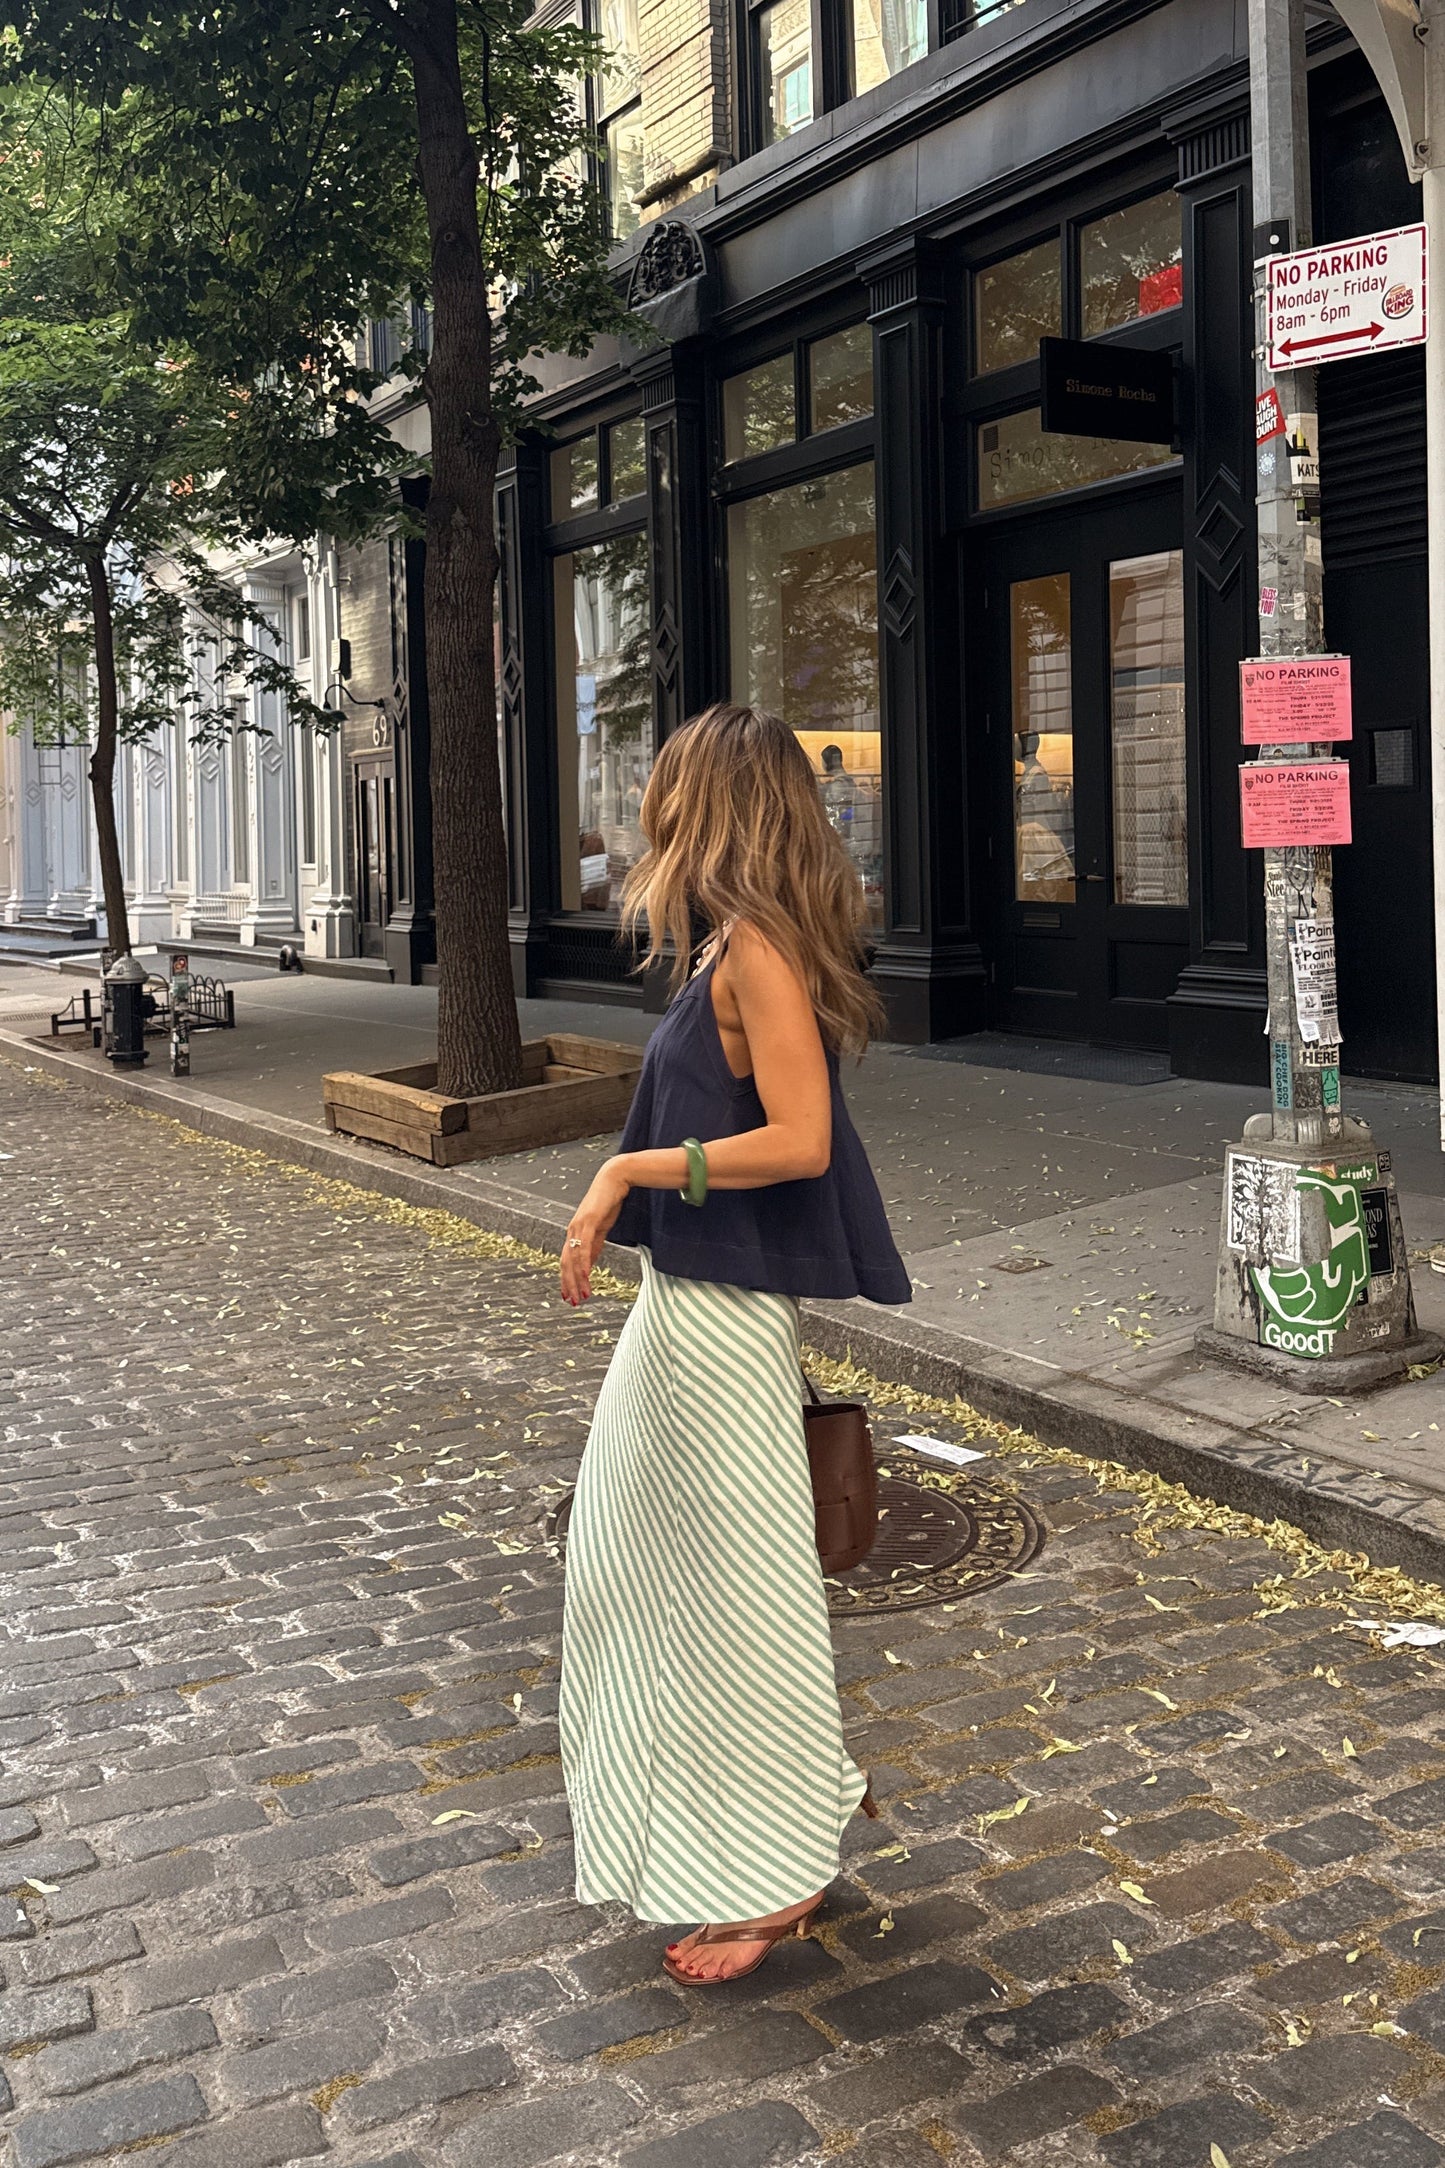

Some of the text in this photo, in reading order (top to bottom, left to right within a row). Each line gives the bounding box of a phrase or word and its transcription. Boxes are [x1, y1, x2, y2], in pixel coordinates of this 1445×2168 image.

[1276, 245, 1388, 288] NO PARKING
[1276, 288, 1329, 311] Monday
[1344, 275, 1387, 297] Friday
[1386, 296, 1414, 316] KING
[1276, 313, 1306, 331] 8am
[1320, 304, 1351, 325] 6pm
[1066, 379, 1156, 402] Simone Rocha
[1256, 666, 1340, 681] NO PARKING
[372, 715, 387, 746] 69
[1255, 773, 1274, 783] NO
[1277, 770, 1338, 782] PARKING
[1298, 962, 1326, 972] FLOOR
[1302, 1050, 1338, 1065] HERE
